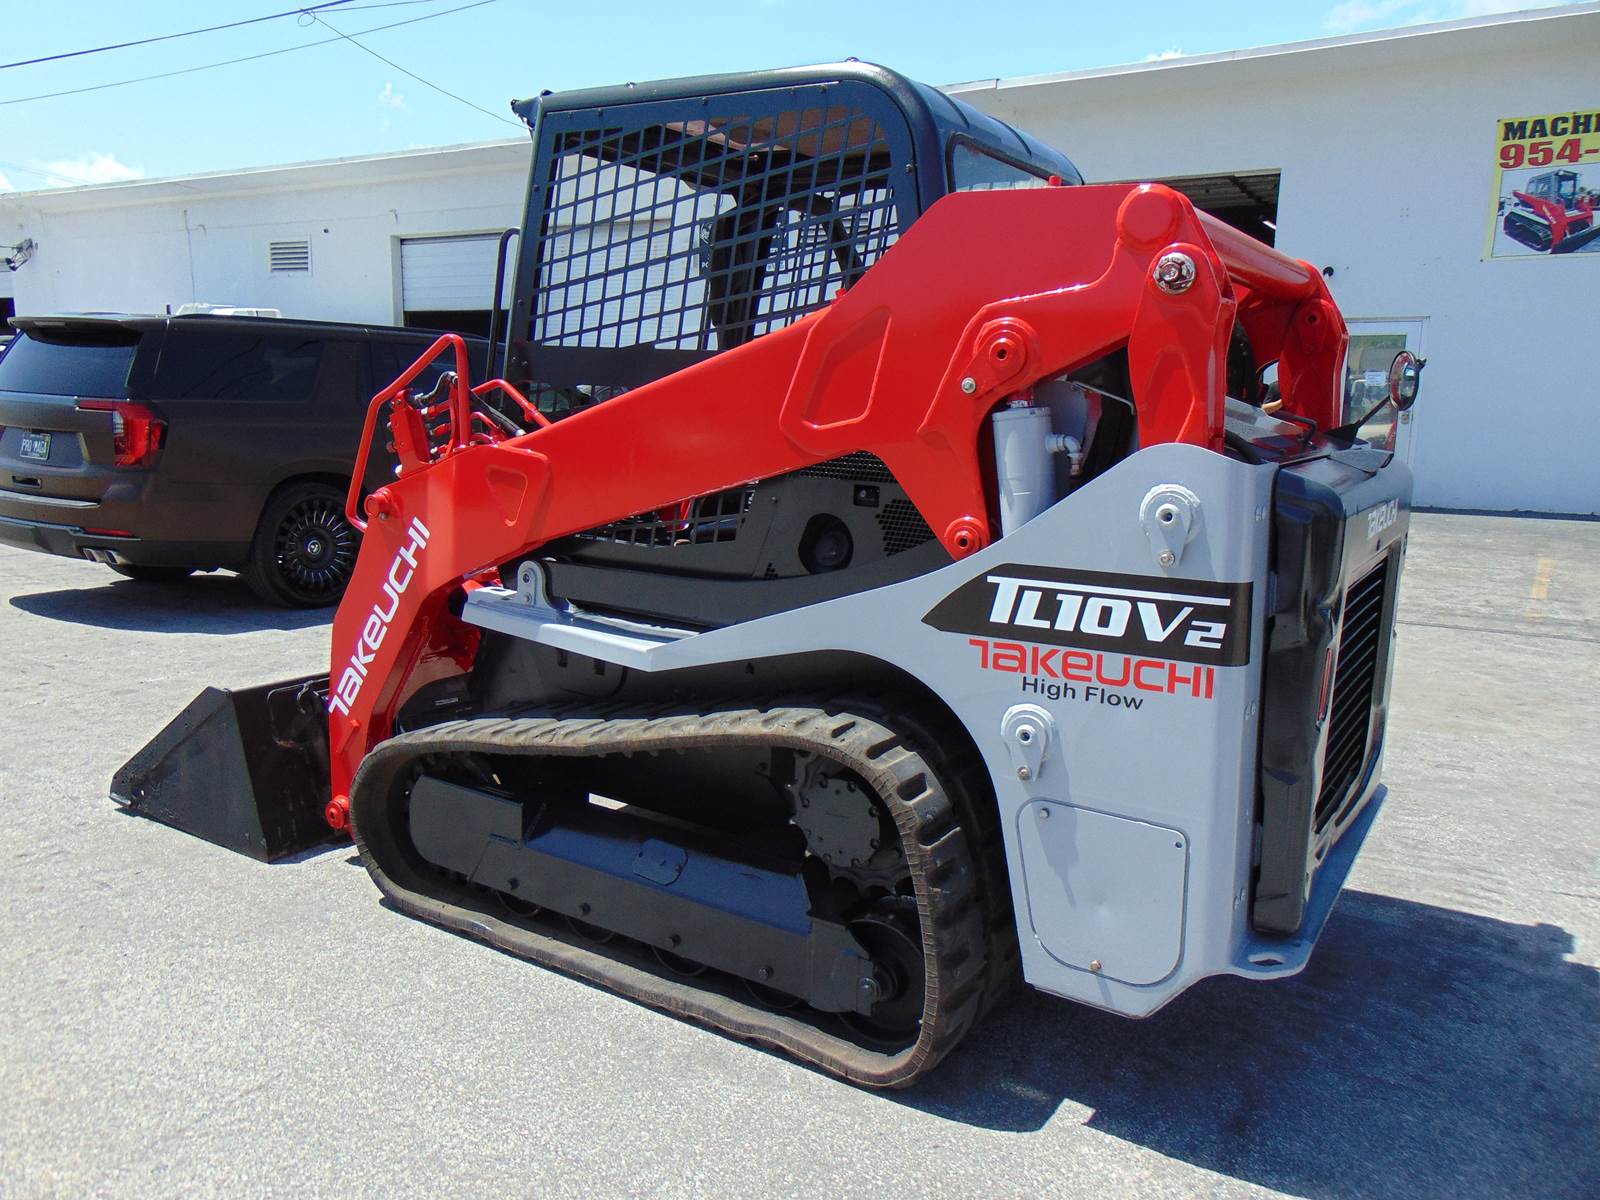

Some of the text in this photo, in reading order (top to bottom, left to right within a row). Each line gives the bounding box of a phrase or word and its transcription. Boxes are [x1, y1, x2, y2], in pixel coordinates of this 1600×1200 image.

[328, 516, 430, 716] TAKEUCHI
[986, 575, 1231, 649] TL10V2
[969, 638, 1215, 699] TAKEUCHI
[1022, 676, 1144, 710] High Flow
